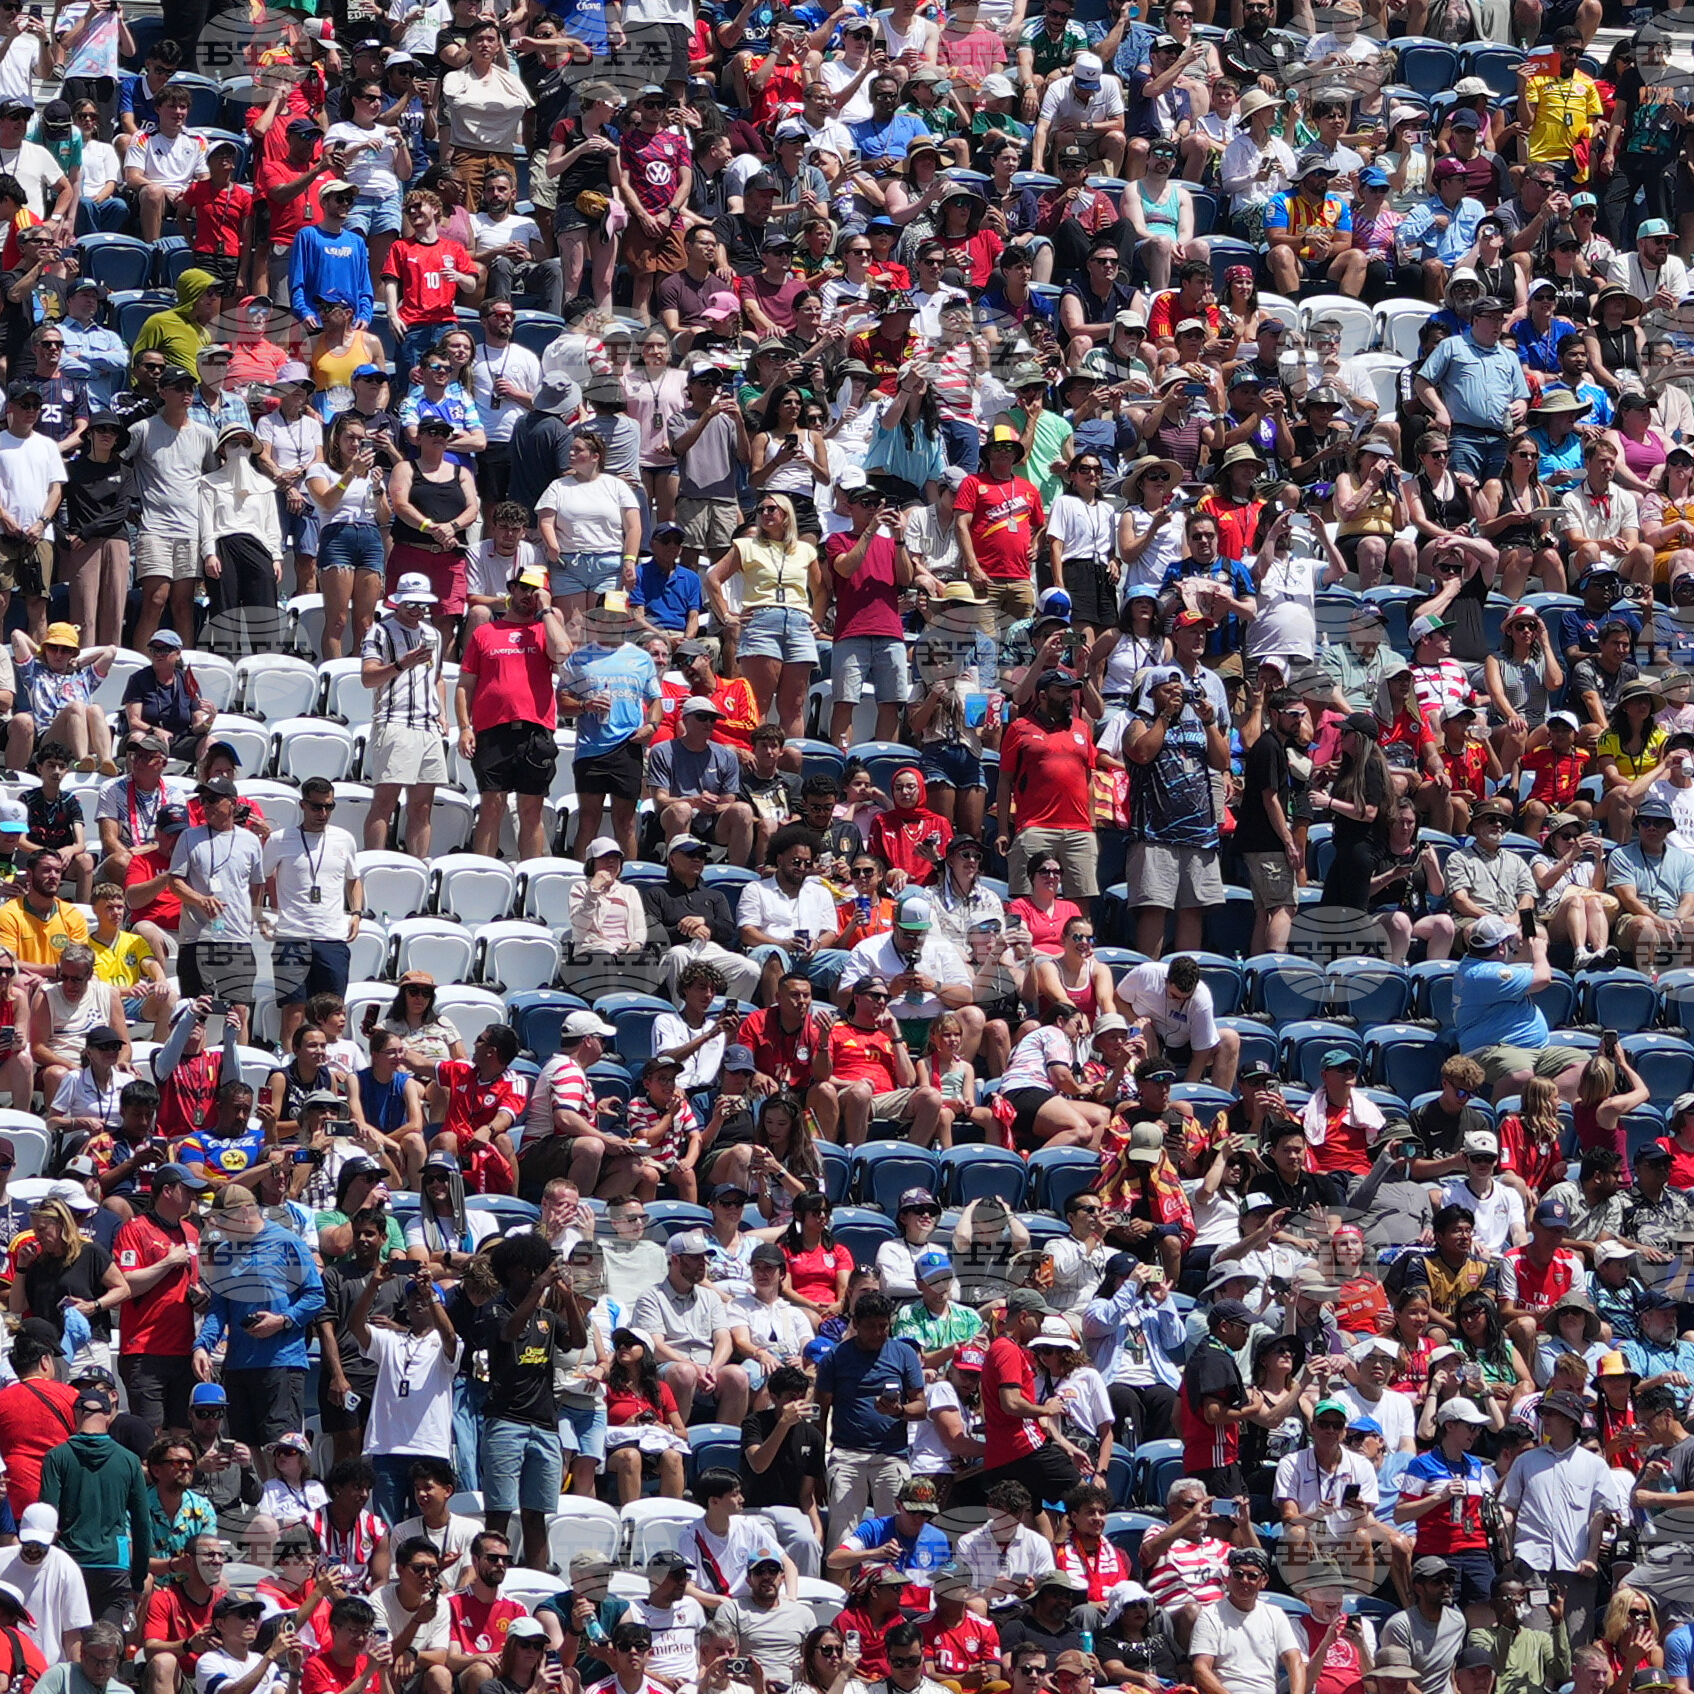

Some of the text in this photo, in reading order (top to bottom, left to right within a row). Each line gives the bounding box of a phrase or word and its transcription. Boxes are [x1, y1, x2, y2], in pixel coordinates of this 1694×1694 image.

[743, 26, 771, 41] BOX
[424, 271, 441, 289] 10
[41, 403, 63, 424] 25
[652, 1643, 695, 1658] mirates
